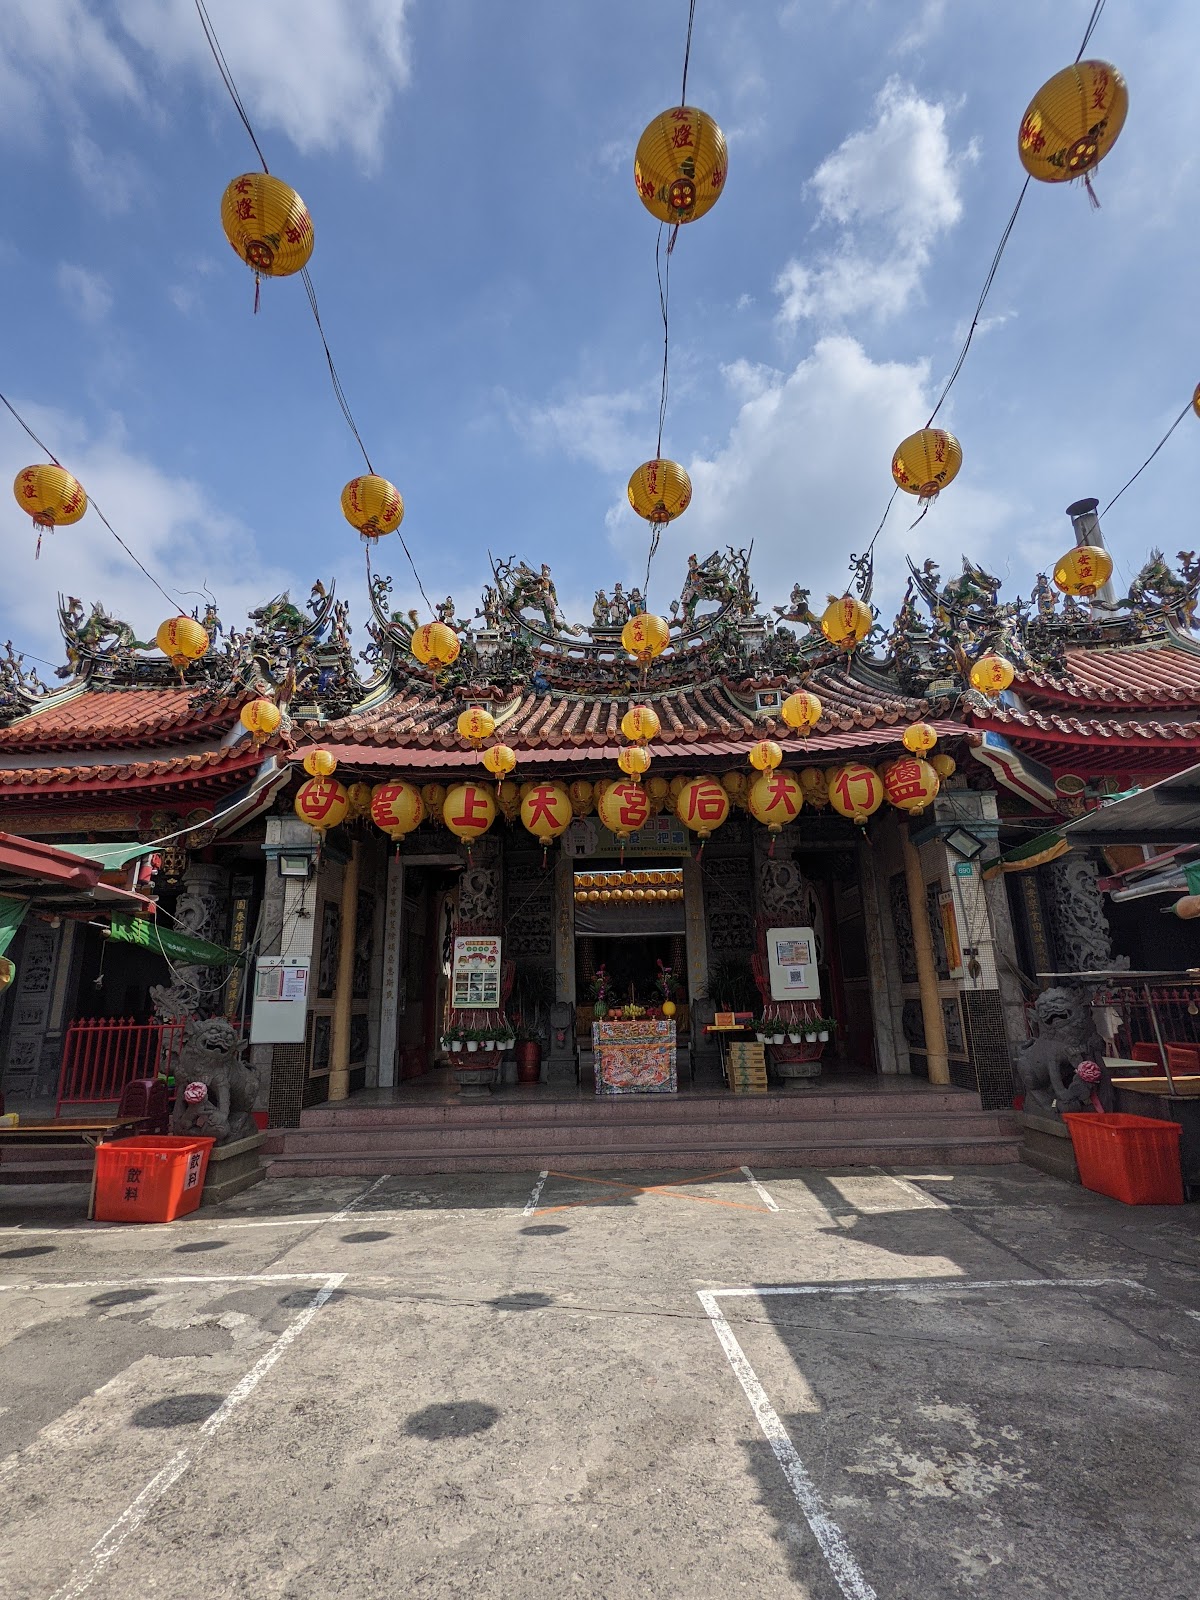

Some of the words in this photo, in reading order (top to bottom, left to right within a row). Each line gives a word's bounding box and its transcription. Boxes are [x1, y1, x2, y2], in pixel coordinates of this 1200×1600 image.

[298, 778, 345, 820] 母
[688, 780, 726, 821] 后
[765, 774, 797, 815] 天
[835, 765, 875, 811] 行
[884, 759, 927, 804] 鹽
[371, 785, 404, 826] 聖
[452, 788, 488, 828] 上
[528, 787, 563, 828] 天
[613, 784, 647, 826] 宮
[124, 1167, 143, 1202] 飲料
[187, 1154, 201, 1188] 飲料
